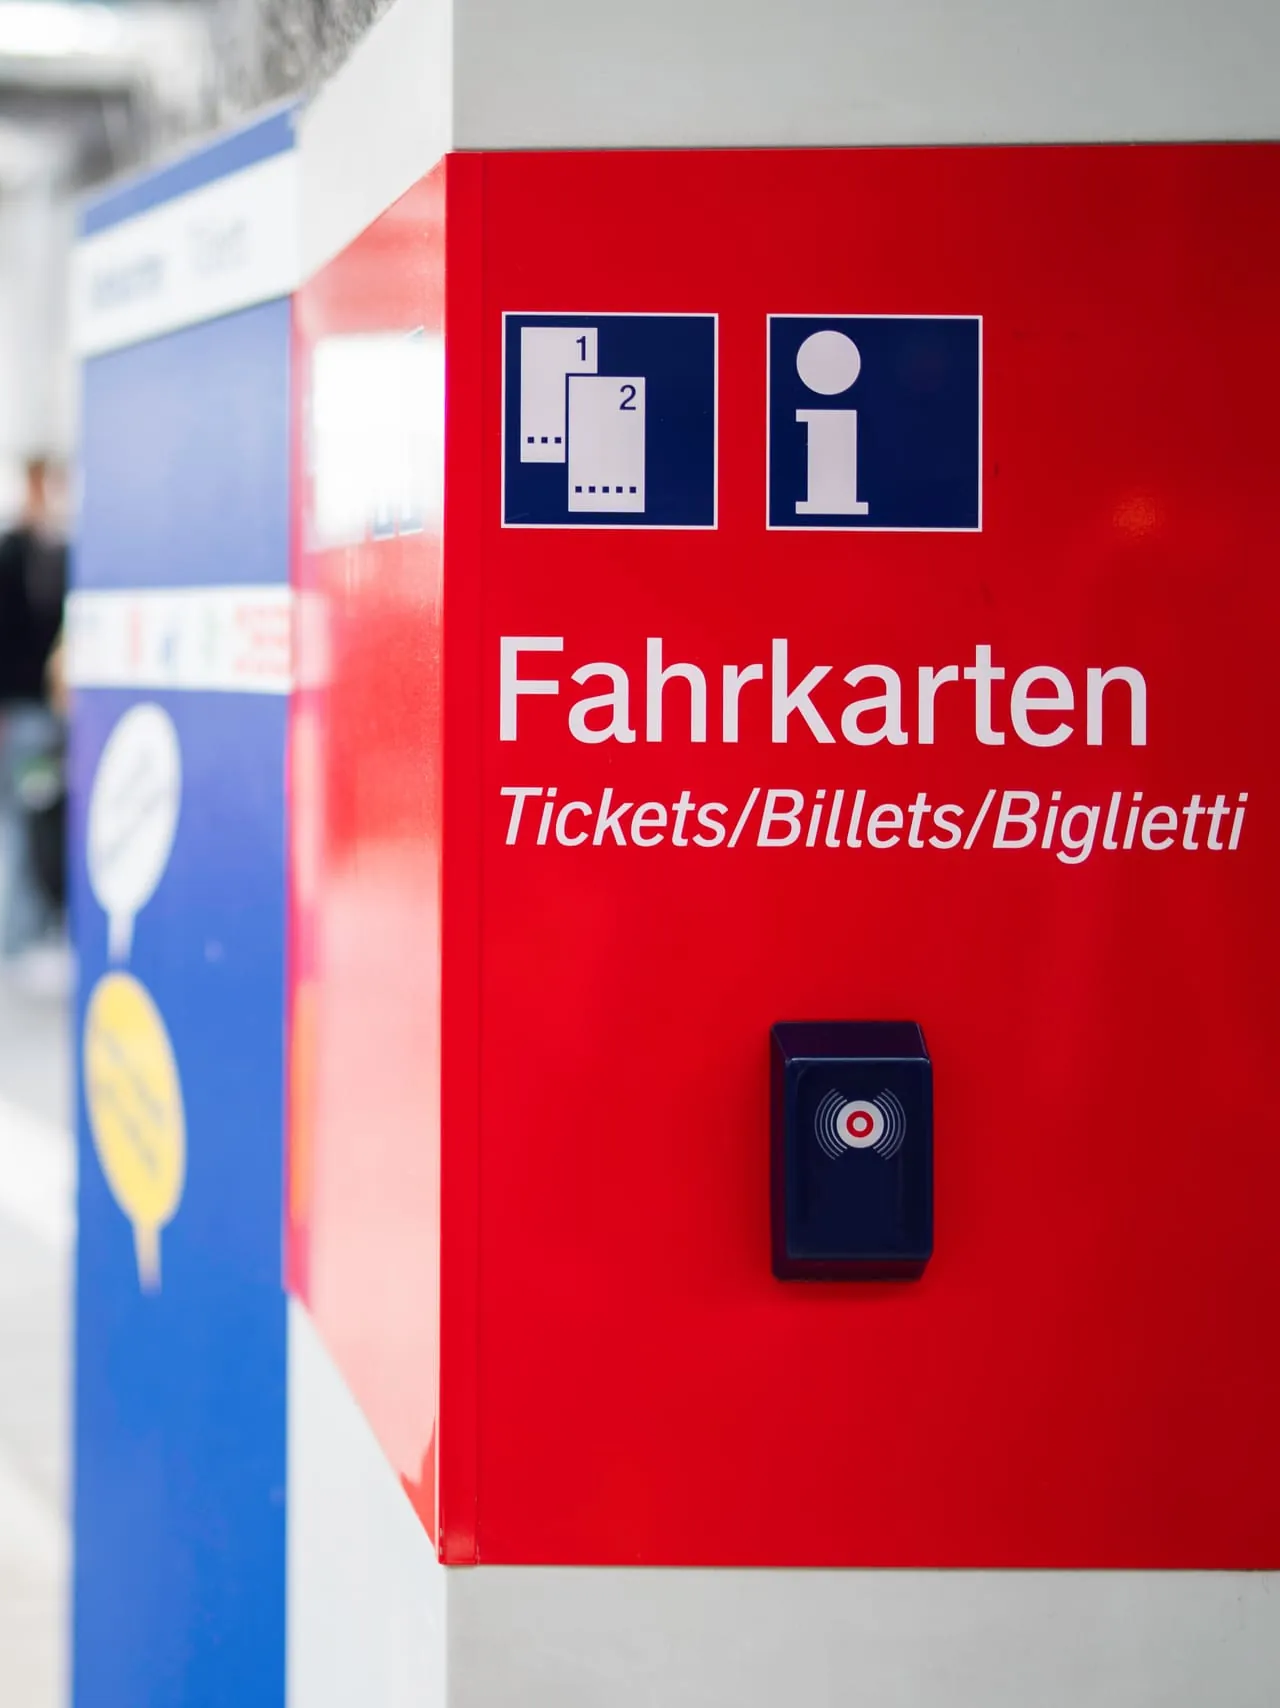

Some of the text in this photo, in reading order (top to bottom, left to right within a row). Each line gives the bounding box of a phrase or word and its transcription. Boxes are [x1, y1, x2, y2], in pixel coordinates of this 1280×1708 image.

[576, 335, 586, 361] 1
[619, 384, 637, 411] 2
[499, 636, 1147, 747] Fahrkarten
[500, 786, 1248, 864] Tickets/Billets/Biglietti
